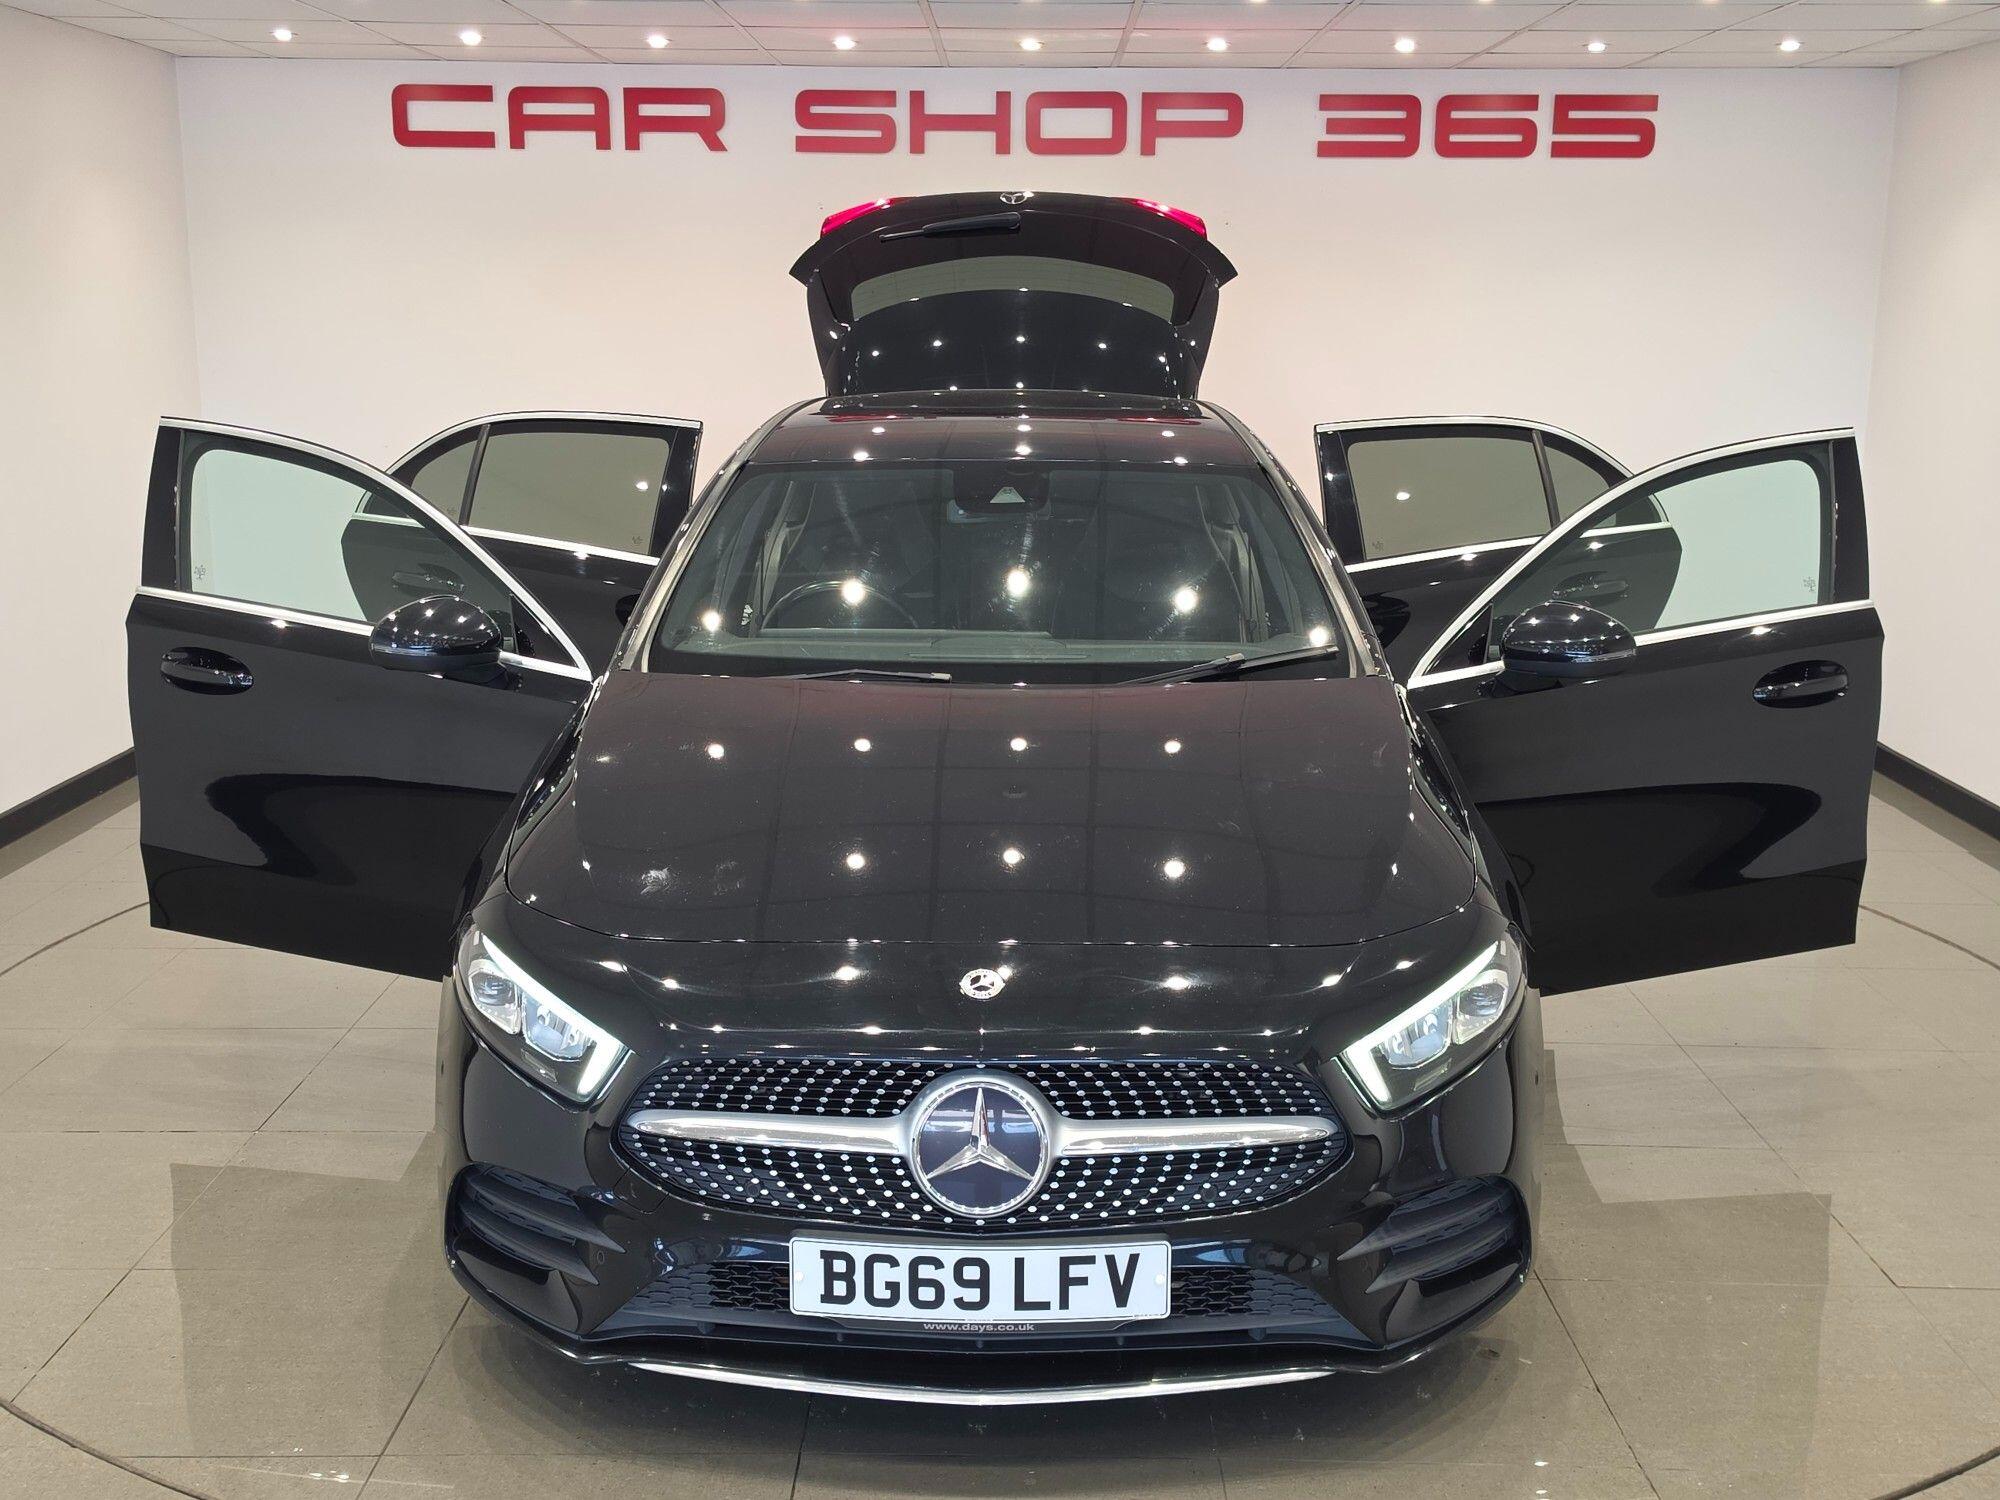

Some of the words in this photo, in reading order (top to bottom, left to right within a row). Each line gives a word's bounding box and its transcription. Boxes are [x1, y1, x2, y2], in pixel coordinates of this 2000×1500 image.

[392, 84, 727, 151] CAR
[796, 90, 1243, 156] SHOP
[1318, 95, 1658, 158] 365
[819, 1249, 990, 1311] BG69
[1014, 1252, 1141, 1311] LFV
[923, 1322, 1035, 1333] www.days.co.uk
